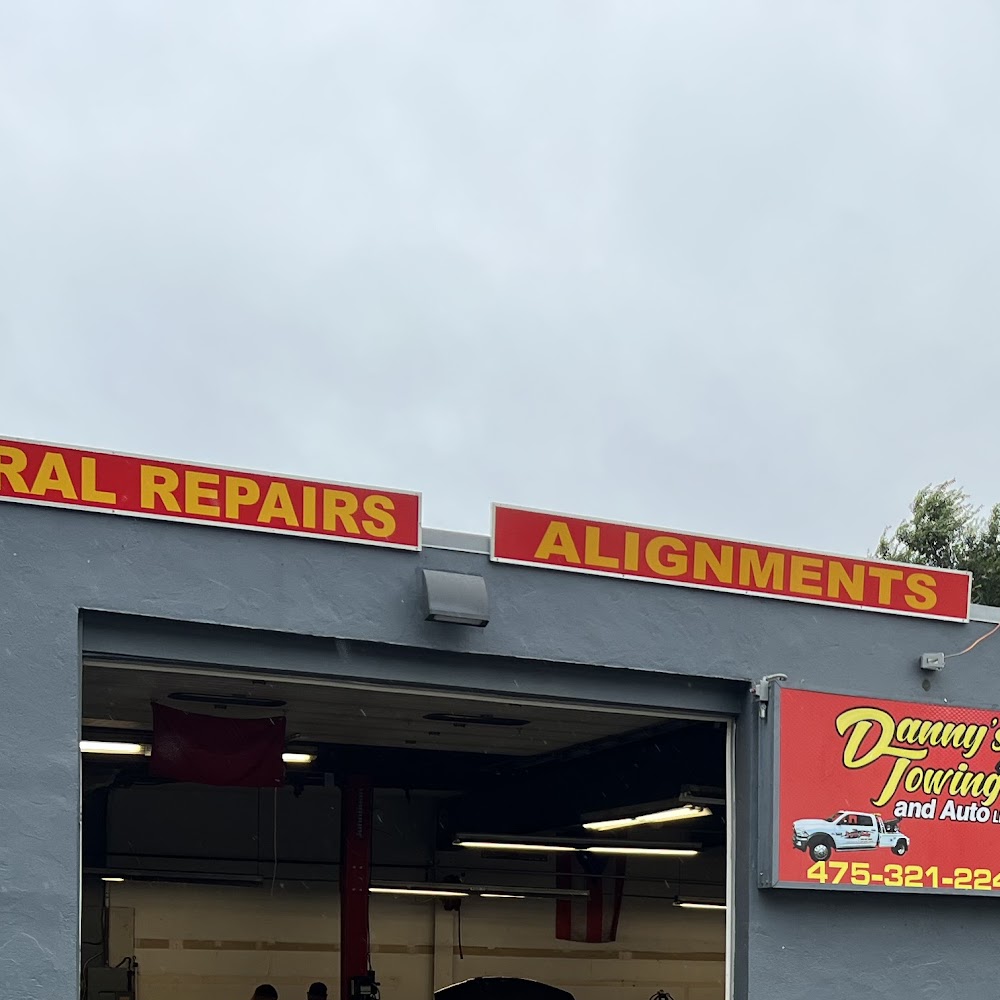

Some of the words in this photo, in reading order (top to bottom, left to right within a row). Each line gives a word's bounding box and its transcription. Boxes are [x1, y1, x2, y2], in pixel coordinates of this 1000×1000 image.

[0, 445, 117, 505] RAL
[140, 464, 396, 538] REPAIRS
[533, 520, 938, 610] ALIGNMENTS
[894, 798, 937, 820] and
[939, 800, 990, 823] Auto
